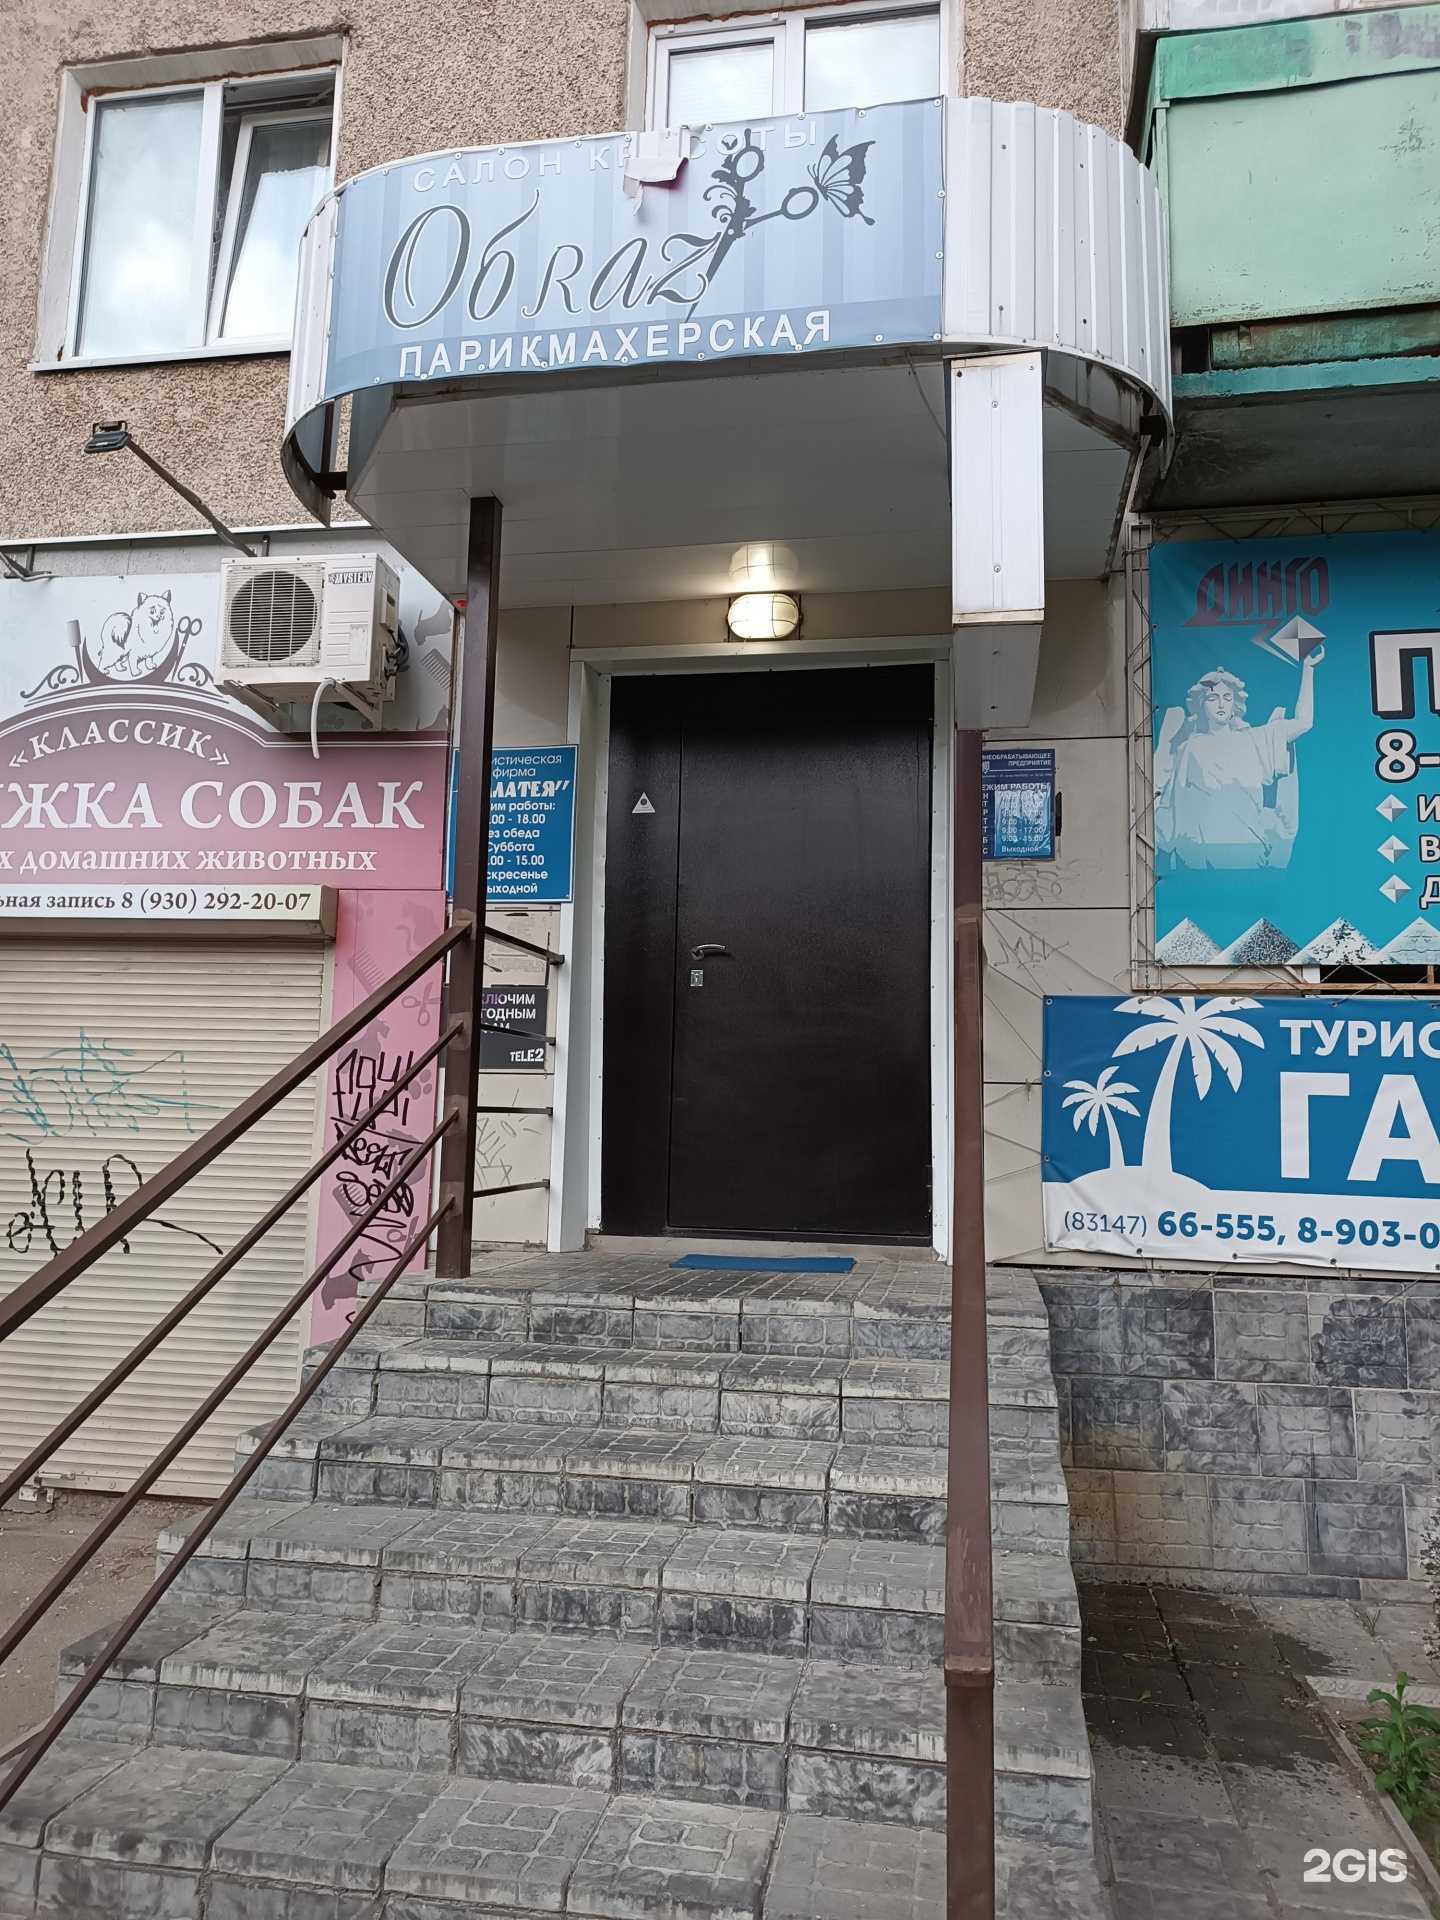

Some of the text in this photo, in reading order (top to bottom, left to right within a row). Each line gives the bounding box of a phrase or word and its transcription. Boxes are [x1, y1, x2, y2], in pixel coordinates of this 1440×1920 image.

[413, 119, 817, 193] САЛОН КСОТЫ
[399, 310, 832, 379] ПАРИКМАХЕРСКАЯ
[1369, 629, 1440, 719] П
[491, 755, 562, 766] истическая
[492, 767, 536, 779] фирма
[0, 780, 425, 829] ЖКА СОБАК
[509, 801, 556, 812] работы:
[517, 814, 546, 825] 18.00
[503, 828, 540, 839] обеда
[20, 851, 190, 876] домашних
[196, 851, 377, 871] животных
[516, 855, 545, 866] 15.00
[487, 871, 549, 882] скресенье
[487, 883, 538, 895] ыходной
[46, 896, 116, 909] запись
[121, 891, 134, 909] 8
[140, 889, 197, 914] (930)
[204, 891, 312, 911] 292-20-07
[509, 1048, 544, 1062] TELE2
[1064, 1210, 1148, 1238] (83147)
[1157, 1210, 1287, 1247] 66-555,
